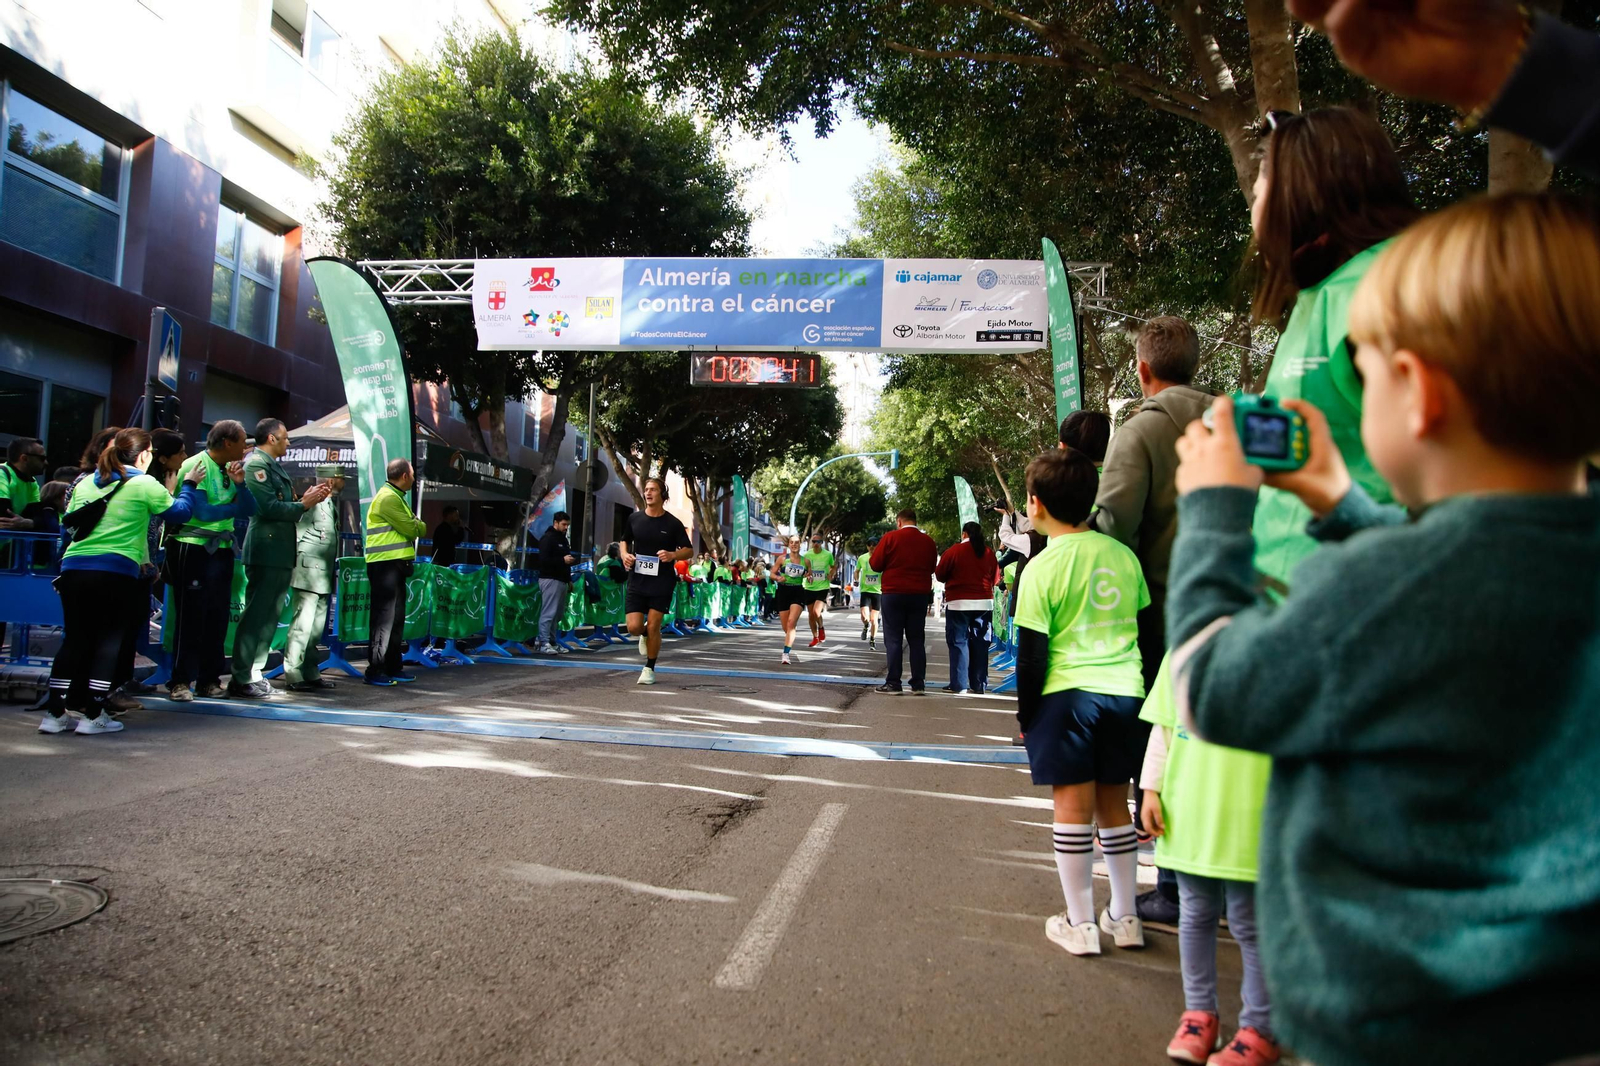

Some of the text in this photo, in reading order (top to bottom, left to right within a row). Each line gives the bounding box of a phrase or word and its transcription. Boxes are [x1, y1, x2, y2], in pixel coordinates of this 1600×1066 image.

[638, 266, 867, 287] Almería en marcha
[913, 271, 963, 284] cajamar
[637, 293, 836, 314] contra el cáncer
[959, 300, 1015, 312] Fundación
[478, 313, 512, 322] ALMERÍA
[916, 324, 941, 332] Toyota
[987, 319, 1033, 329] Ejido Motor
[629, 331, 708, 339] #TodosContraElCáncer
[639, 561, 654, 570] 738
